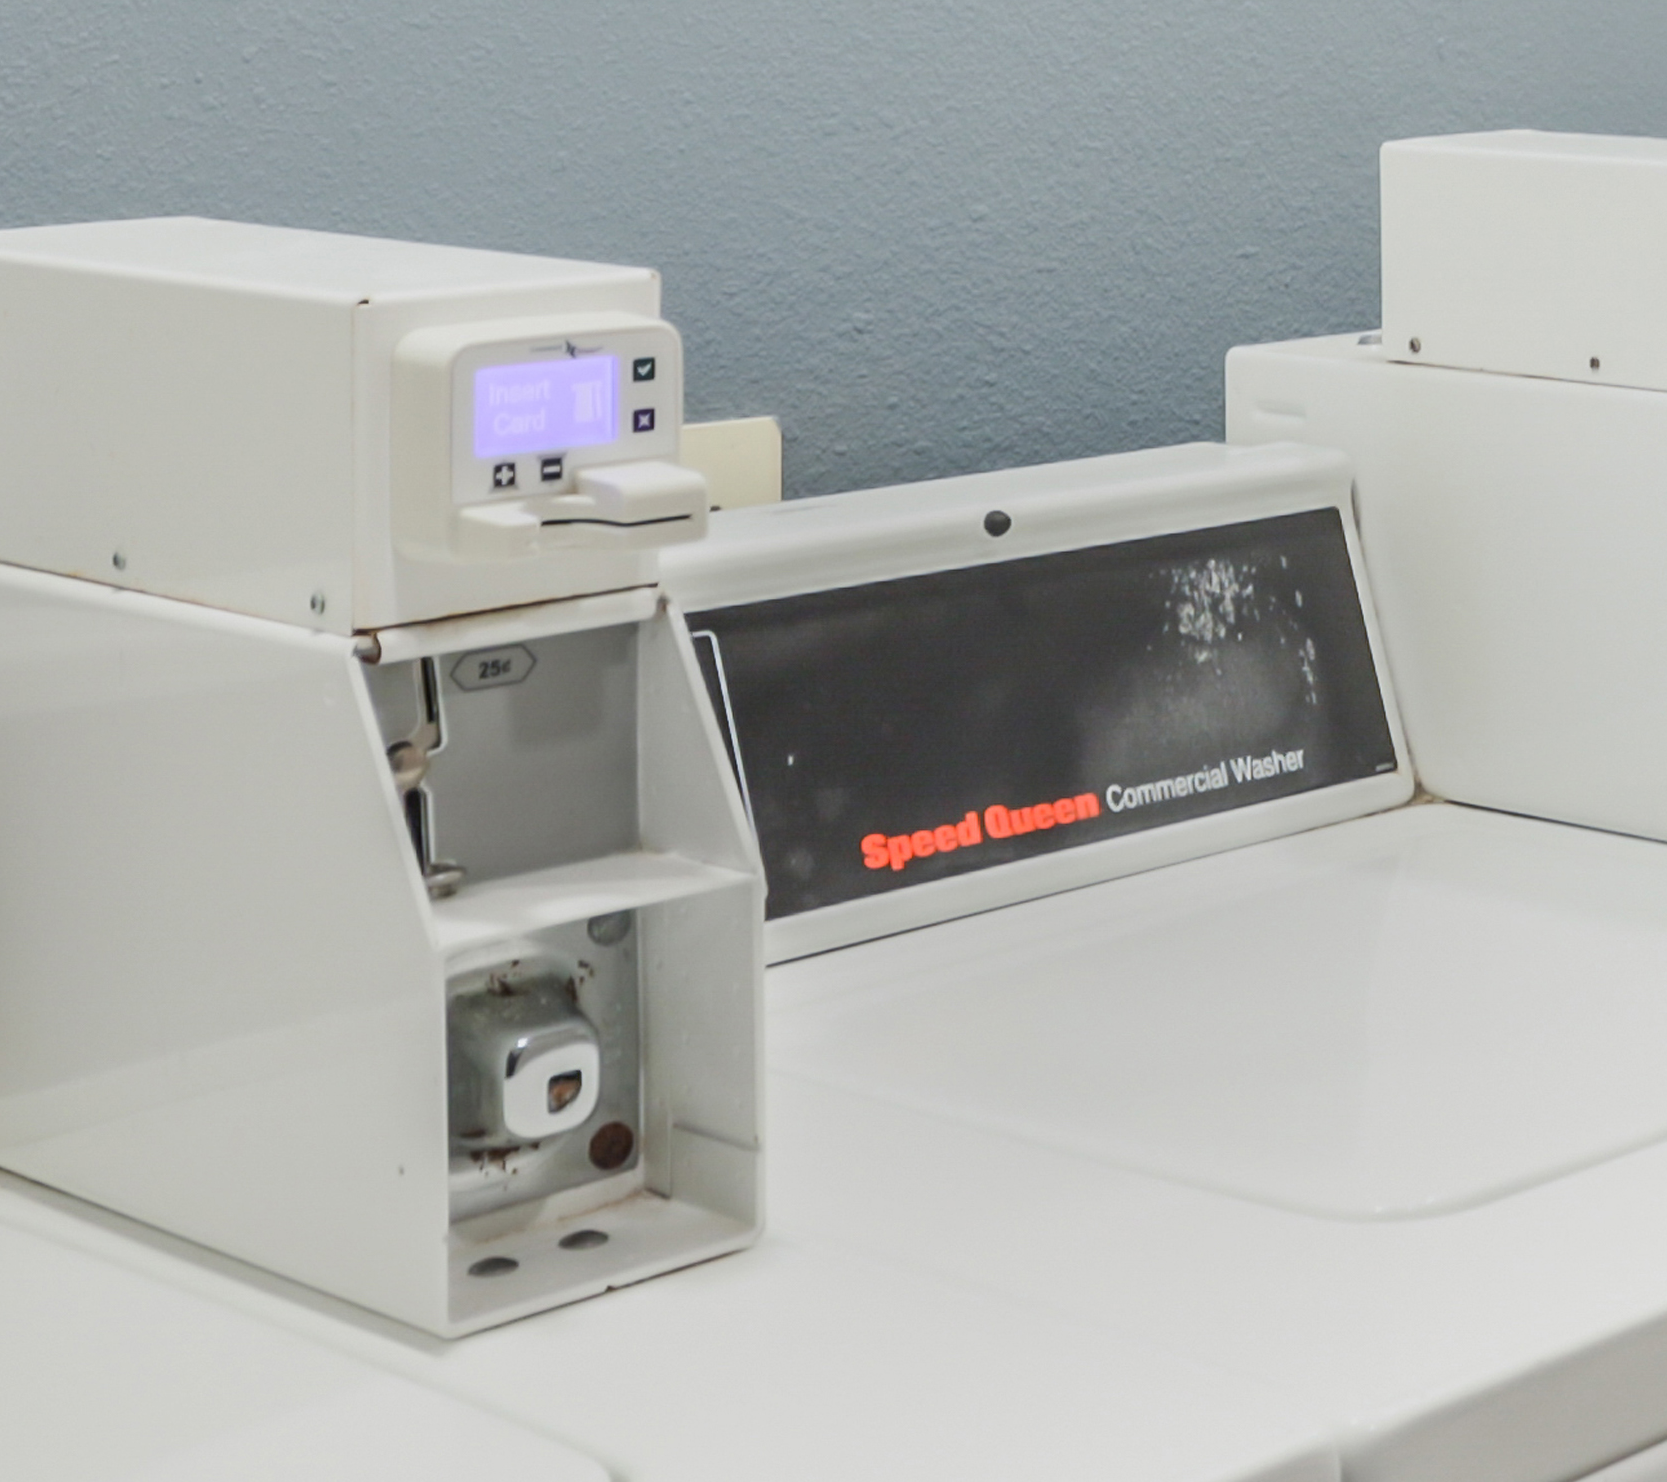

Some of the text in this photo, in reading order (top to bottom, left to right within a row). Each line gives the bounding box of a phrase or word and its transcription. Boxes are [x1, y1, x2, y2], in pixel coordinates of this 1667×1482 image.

[488, 378, 551, 408] Insert
[494, 406, 546, 437] Card
[859, 748, 1306, 872] Speed Queen Commercial Washer
